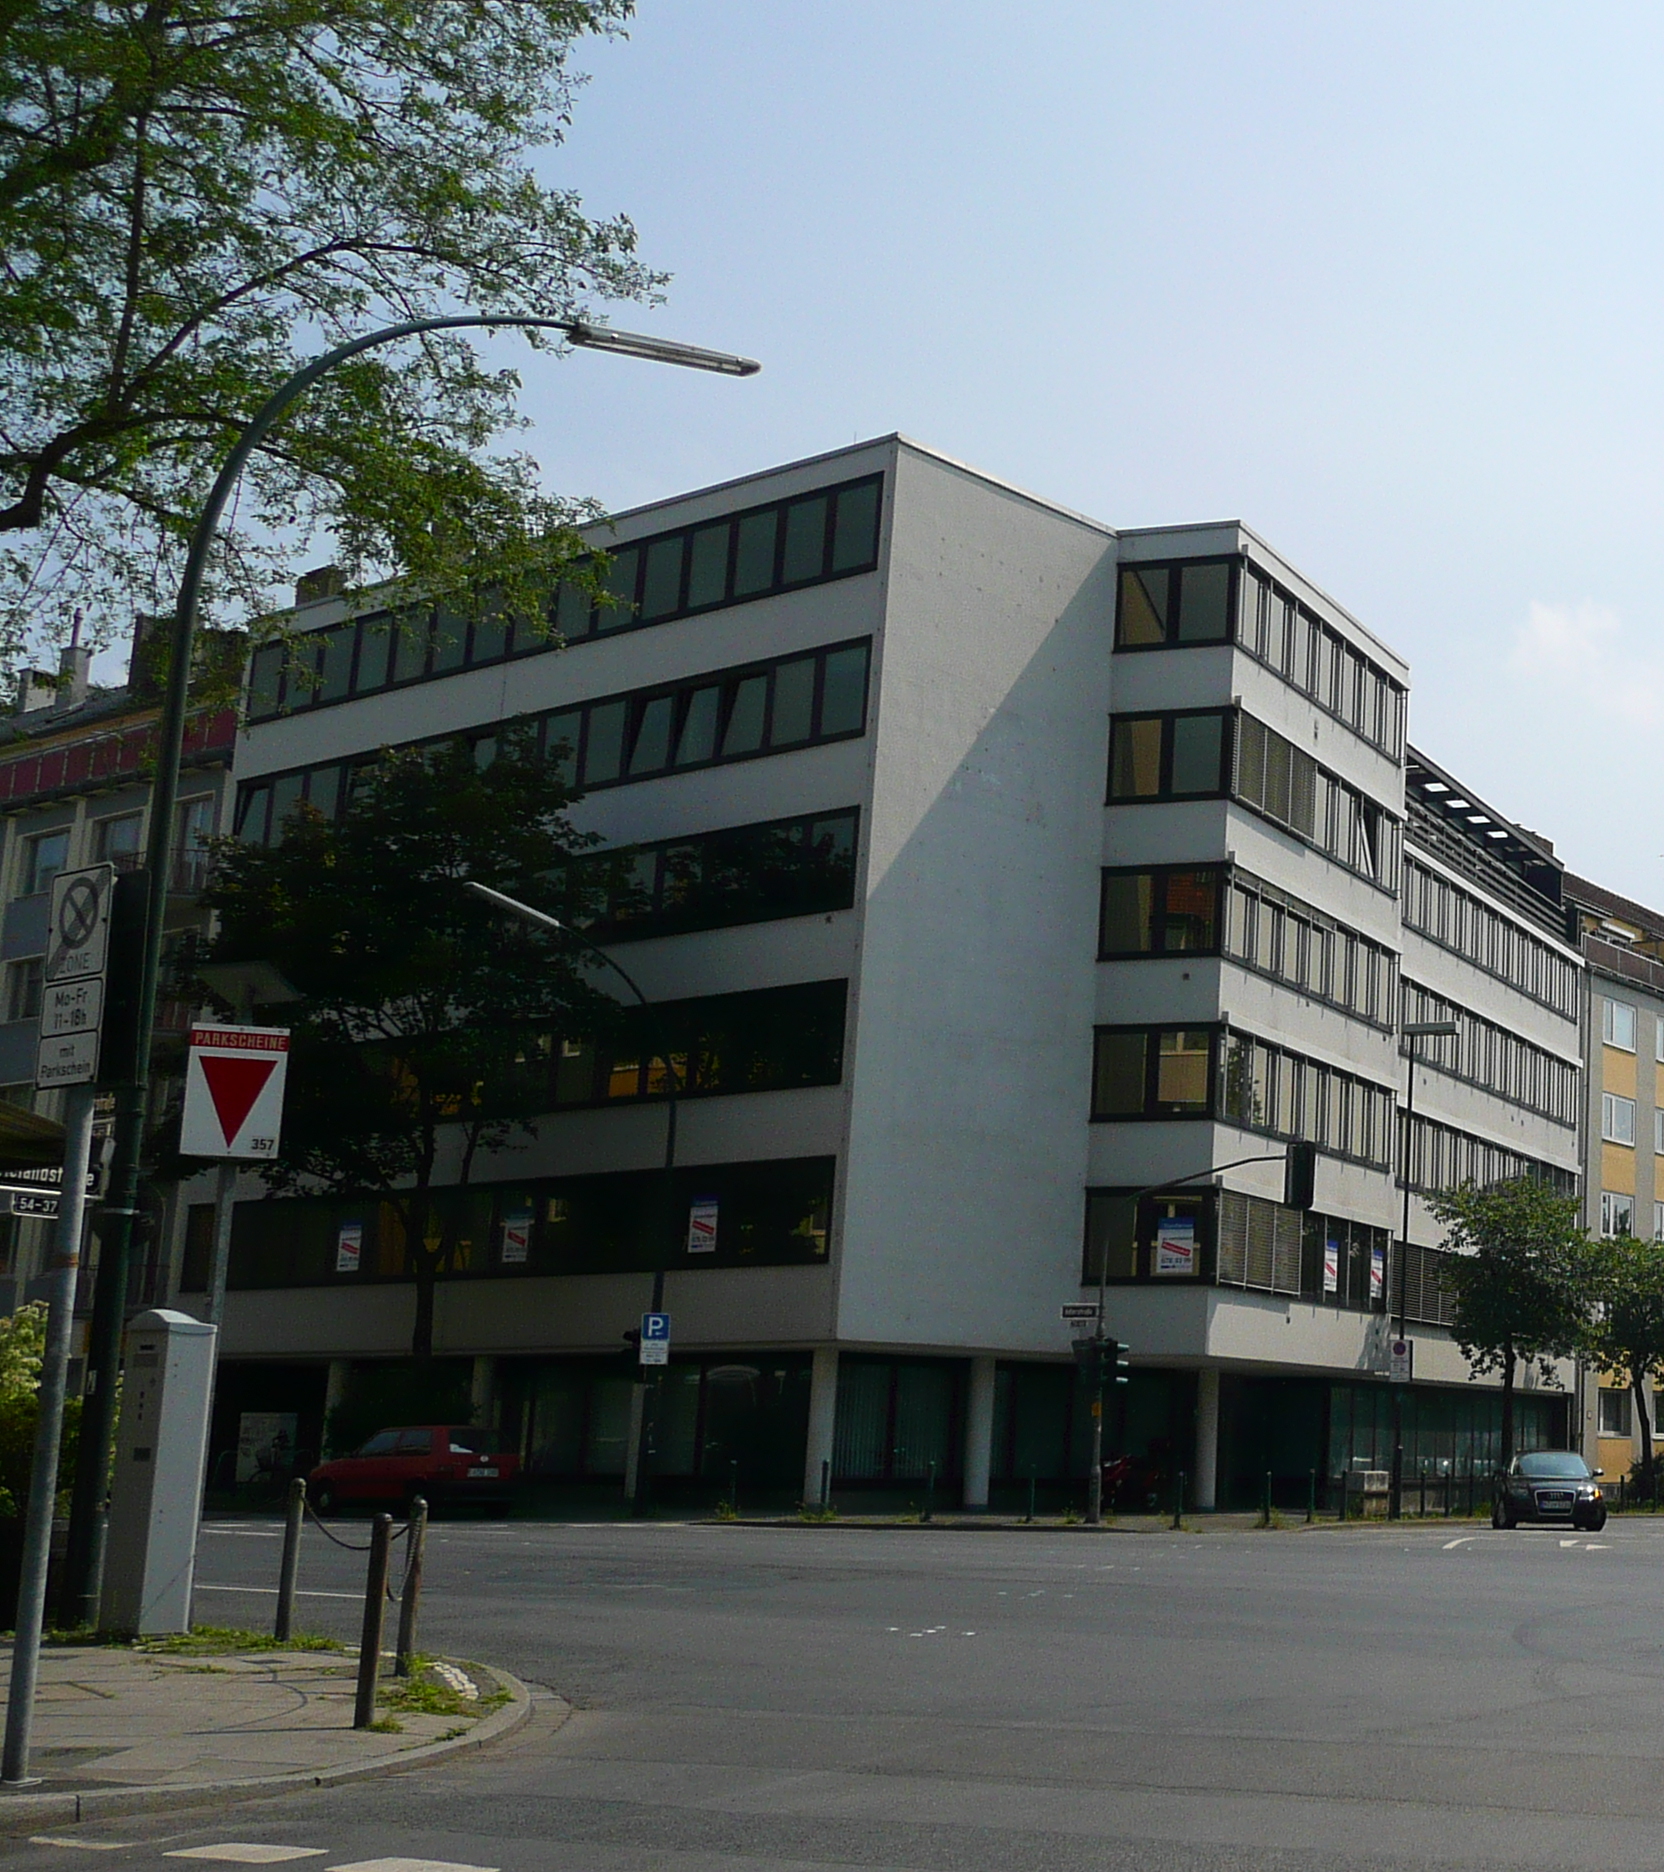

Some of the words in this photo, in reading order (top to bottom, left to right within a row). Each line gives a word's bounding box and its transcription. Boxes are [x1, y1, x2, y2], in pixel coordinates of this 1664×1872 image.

[195, 1031, 286, 1050] PARKSCHEINE
[59, 1043, 75, 1058] mit
[40, 1060, 91, 1078] Parkschein
[251, 1138, 275, 1151] 357
[19, 1197, 58, 1213] 54-37
